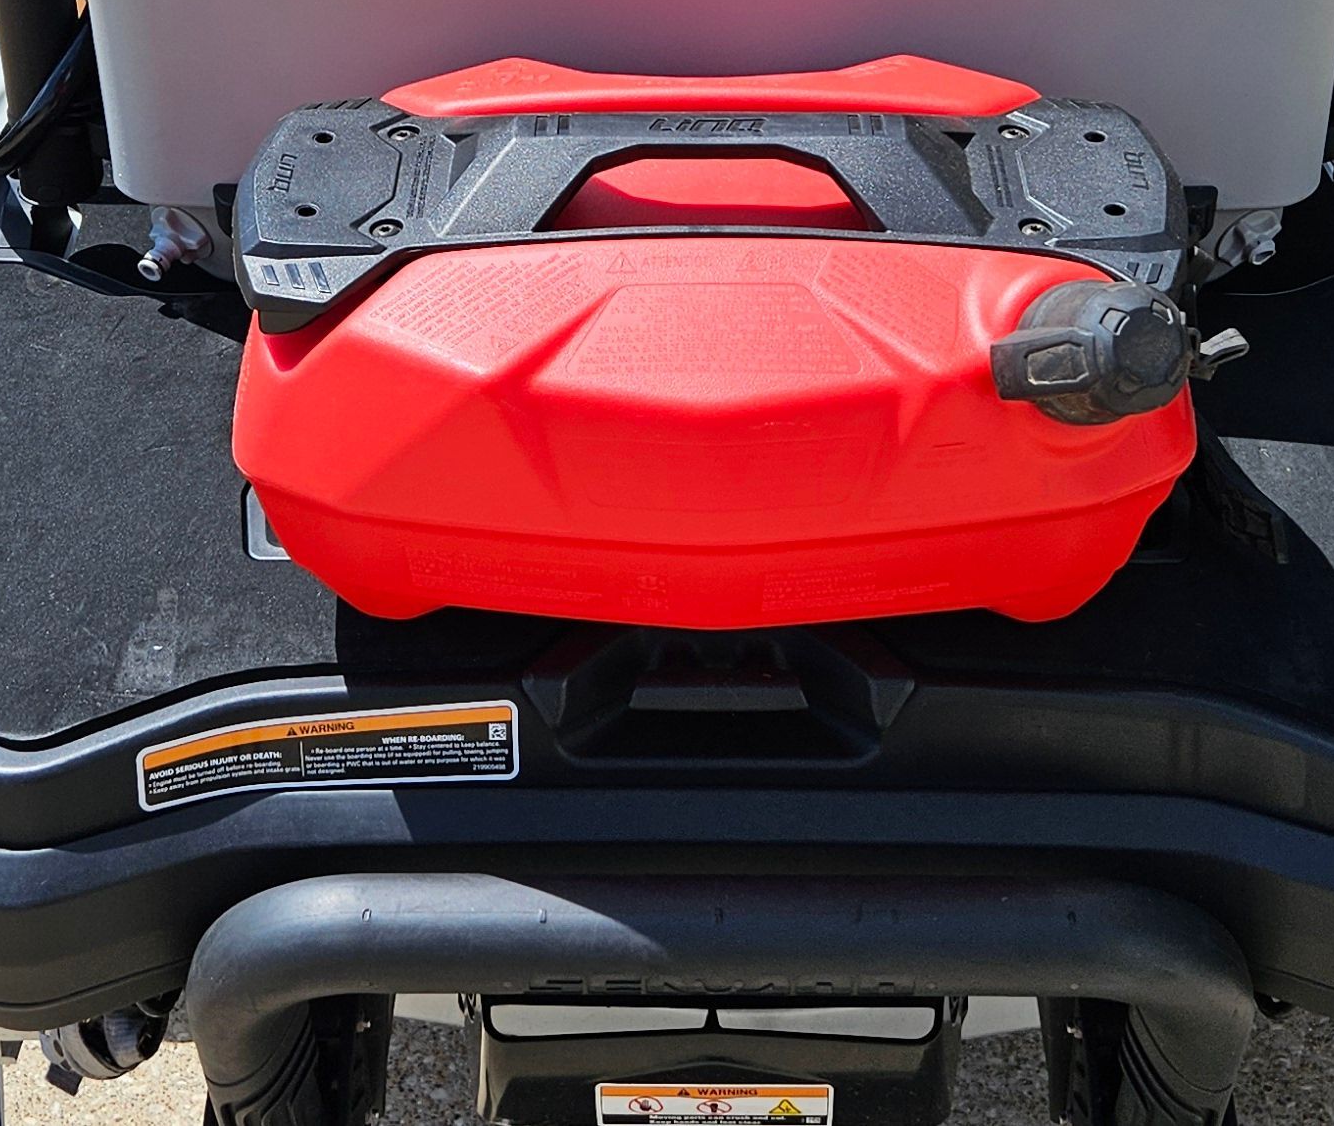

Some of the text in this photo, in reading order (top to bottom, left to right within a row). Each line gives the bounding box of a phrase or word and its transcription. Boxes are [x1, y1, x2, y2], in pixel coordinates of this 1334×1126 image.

[299, 721, 355, 734] WARNING
[381, 736, 406, 744] WHEN
[149, 769, 174, 780] AVOID
[175, 762, 208, 774] SERIOUS
[210, 756, 237, 766] INJURY
[697, 1088, 758, 1096] WARNING
